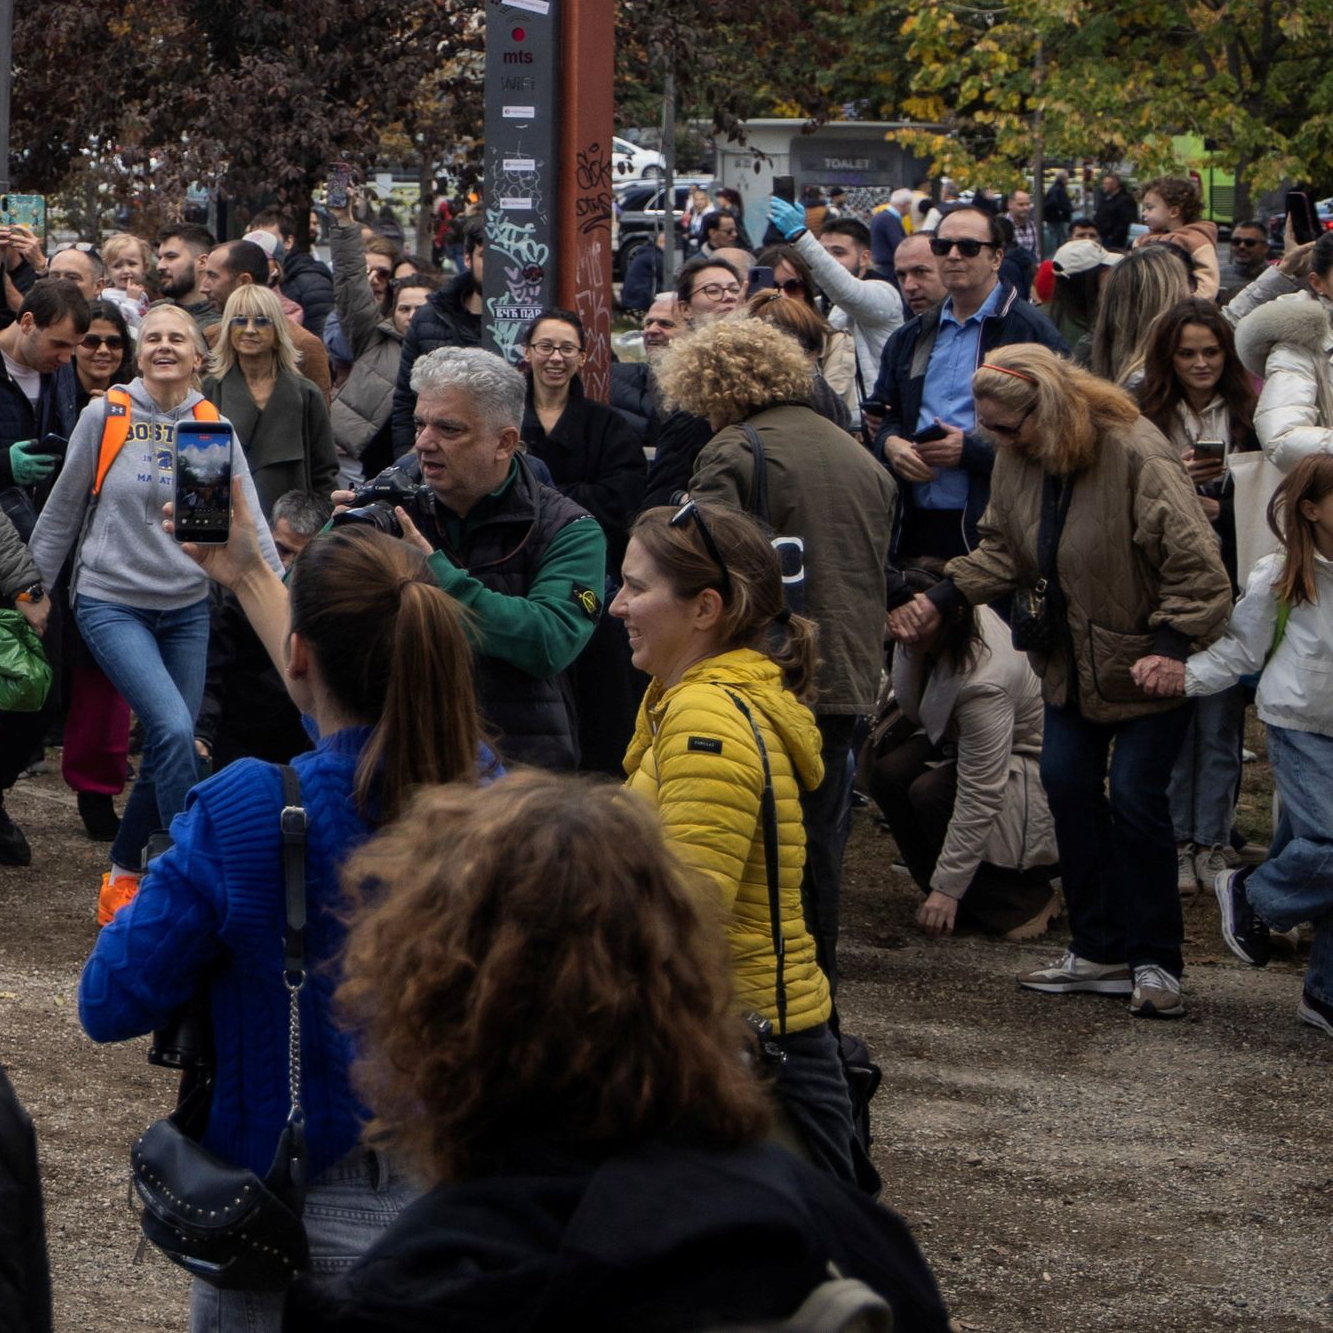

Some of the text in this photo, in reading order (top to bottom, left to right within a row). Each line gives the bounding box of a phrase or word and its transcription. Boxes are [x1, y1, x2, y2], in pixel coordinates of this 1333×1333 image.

[503, 50, 533, 64] mts
[824, 158, 870, 170] TOALET
[137, 473, 172, 485] MAAT
